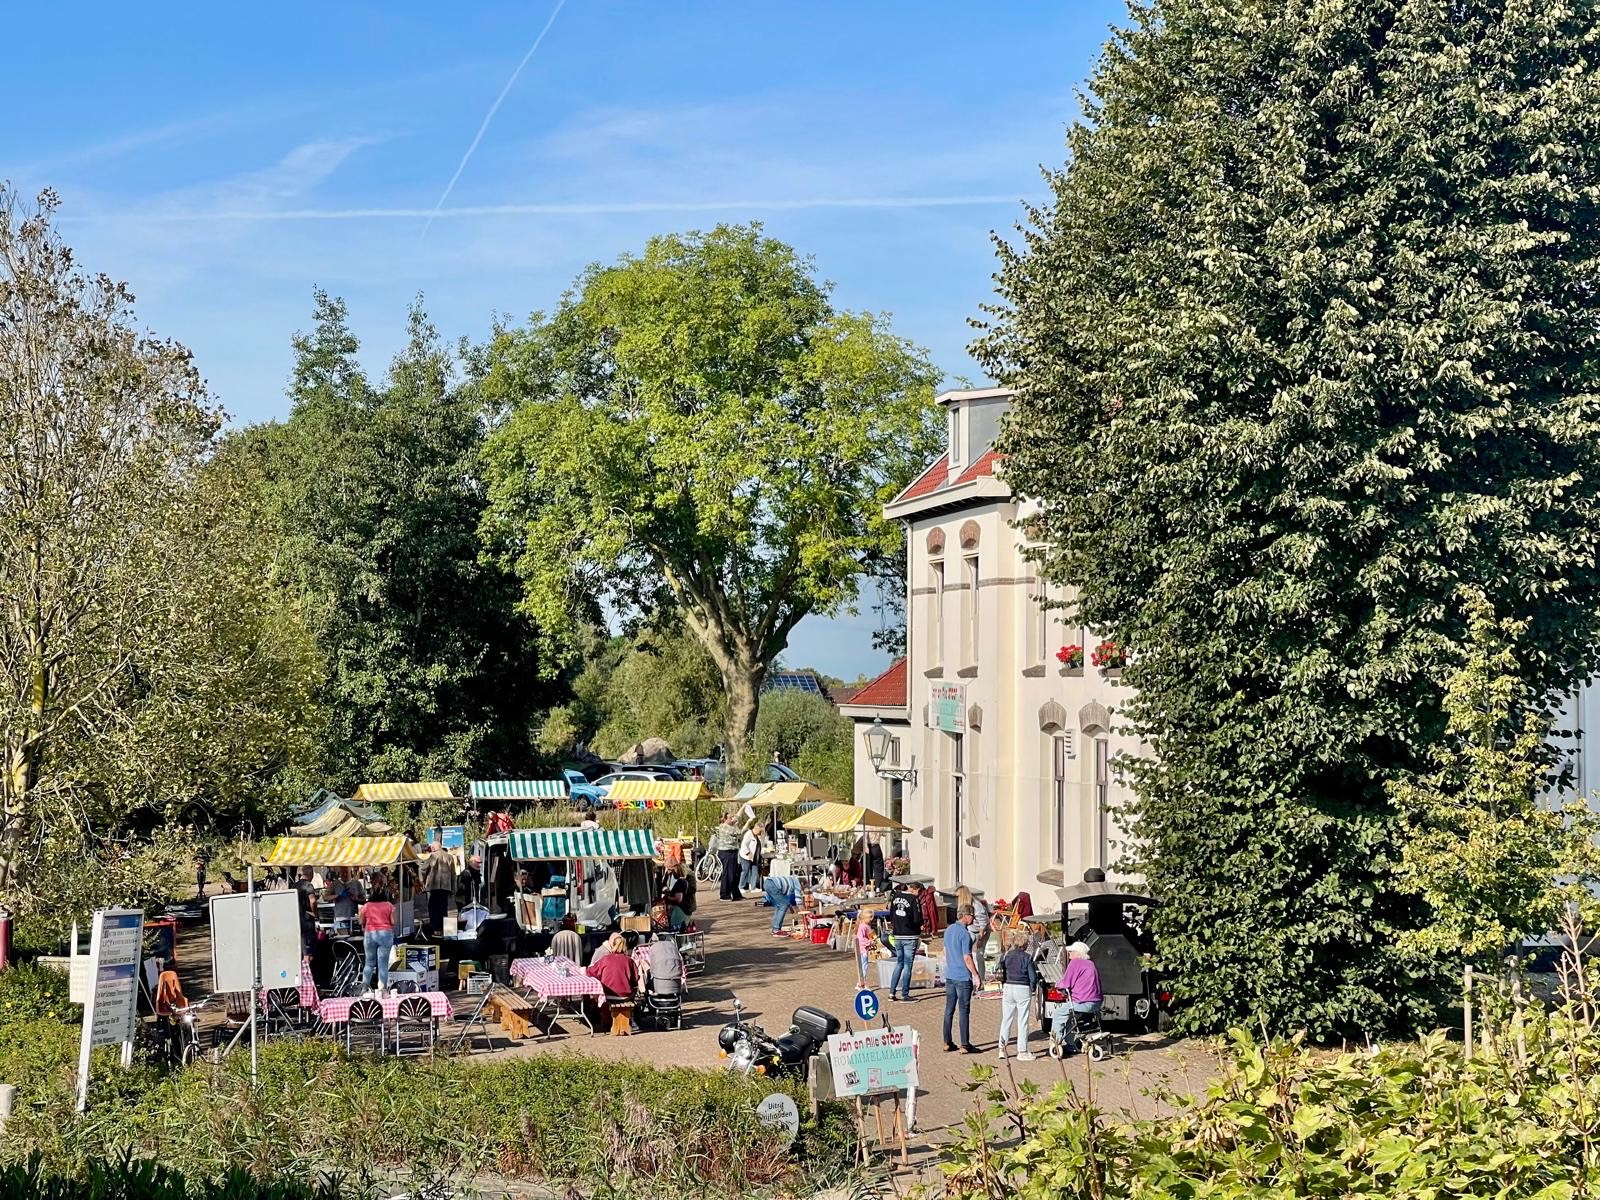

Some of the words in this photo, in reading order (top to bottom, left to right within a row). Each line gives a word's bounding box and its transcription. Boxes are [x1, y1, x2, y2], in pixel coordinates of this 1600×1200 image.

[861, 995, 873, 1015] P
[838, 1040, 852, 1052] Jan
[854, 1040, 863, 1050] en
[881, 1032, 904, 1046] STOOF
